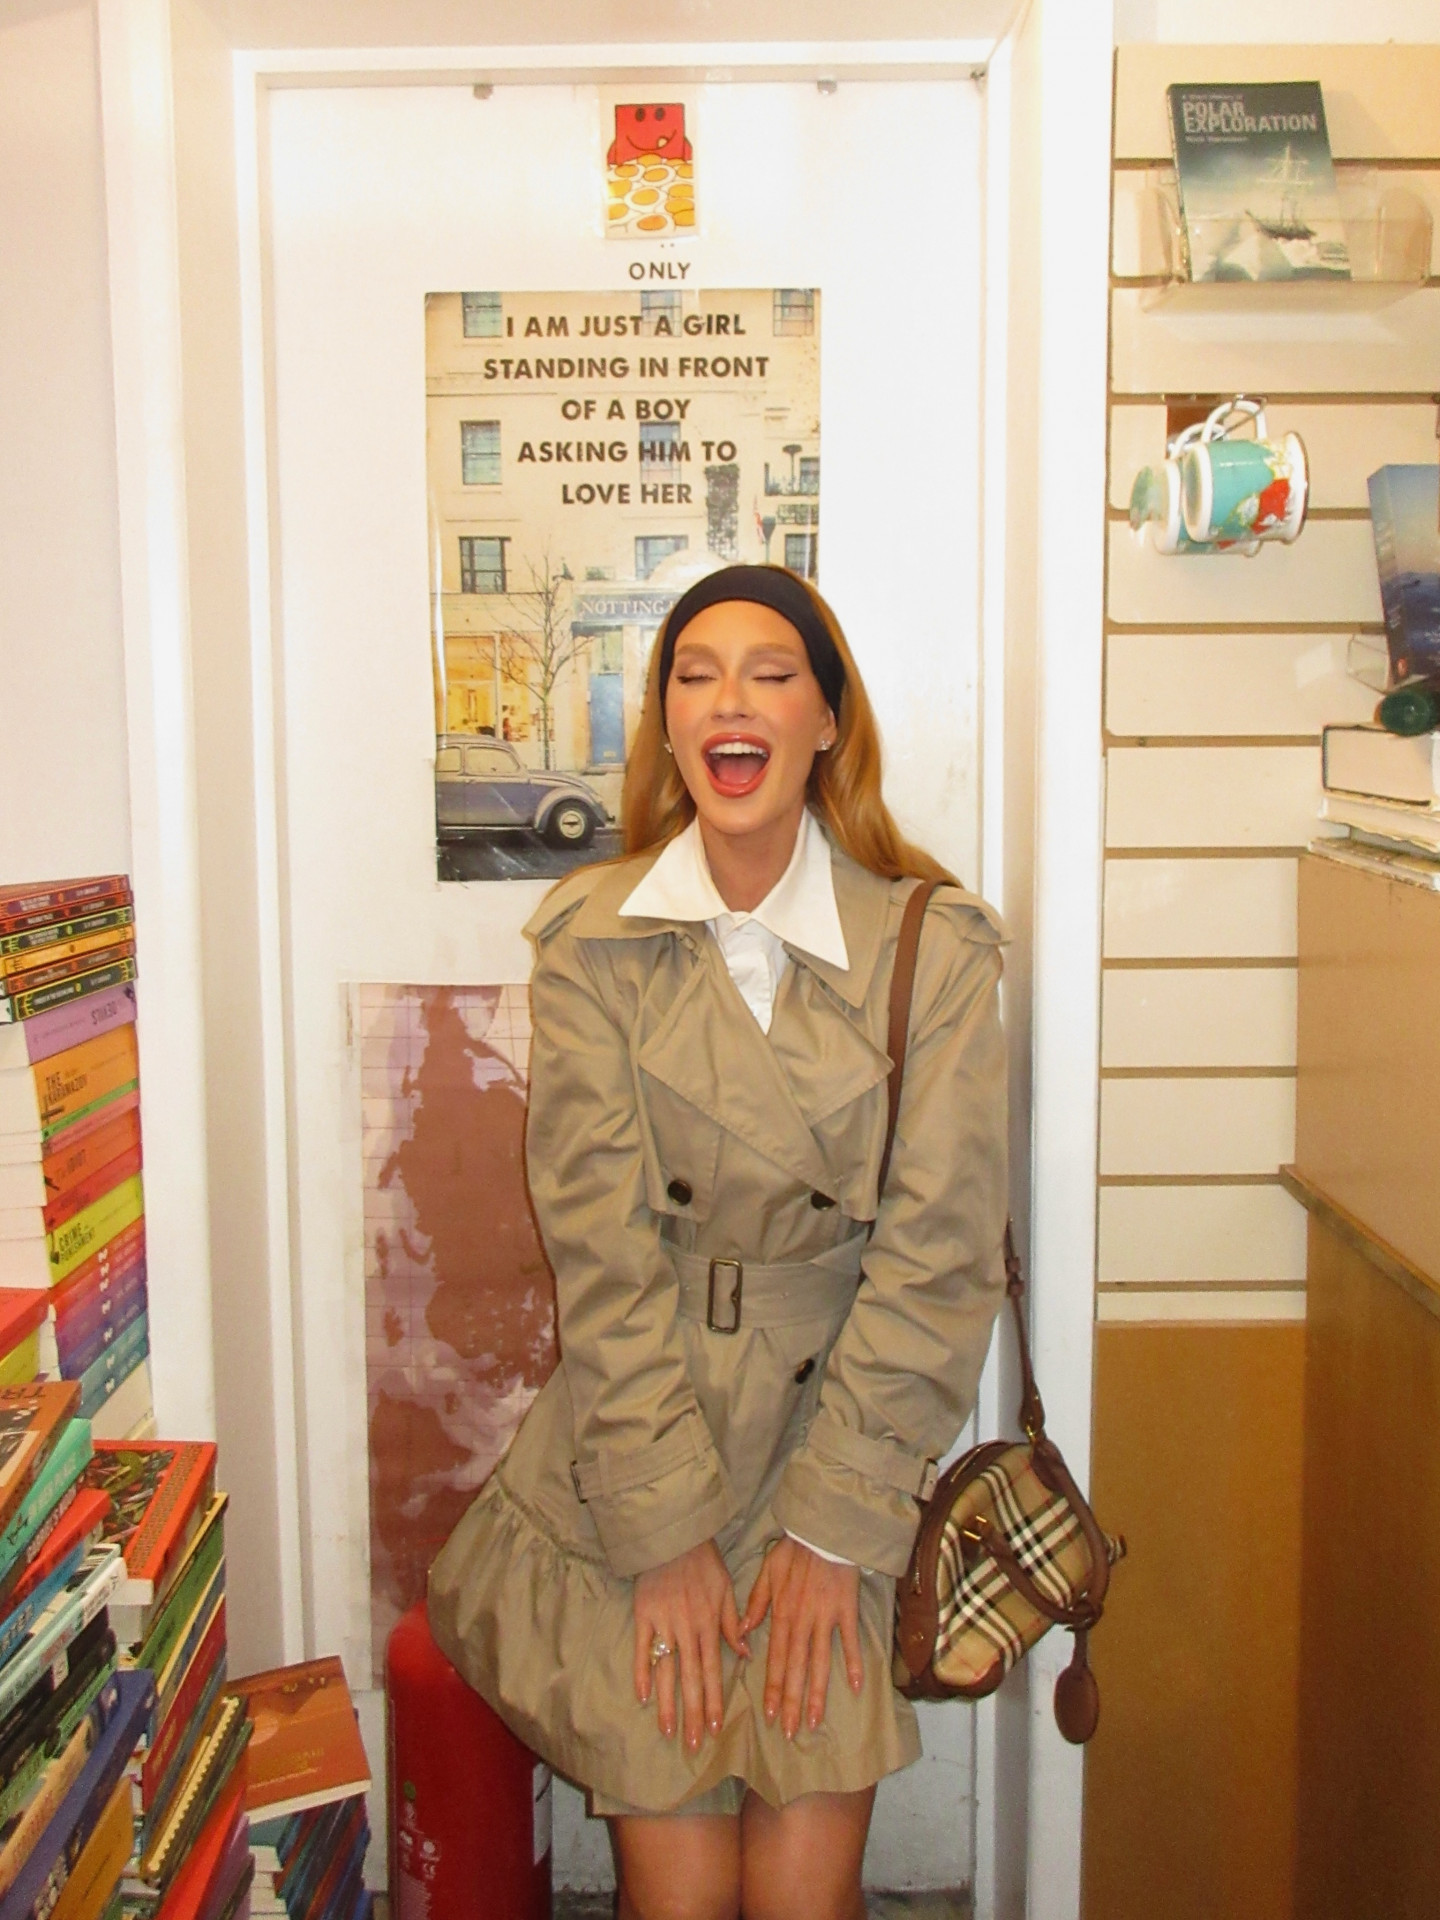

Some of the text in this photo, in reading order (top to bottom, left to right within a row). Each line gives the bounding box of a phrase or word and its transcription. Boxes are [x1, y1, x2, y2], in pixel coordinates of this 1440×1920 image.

[1183, 101, 1245, 117] POLAR
[1185, 114, 1317, 133] EXPLORATION
[629, 262, 691, 280] ONLY
[507, 314, 746, 337] I AM JUST A GIRL
[484, 356, 769, 380] STANDING IN FRONT
[561, 398, 691, 420] OF A BOY
[517, 440, 737, 463] ASKING HIM TO
[562, 483, 692, 505] LOVE HER
[580, 600, 664, 615] NOTTING
